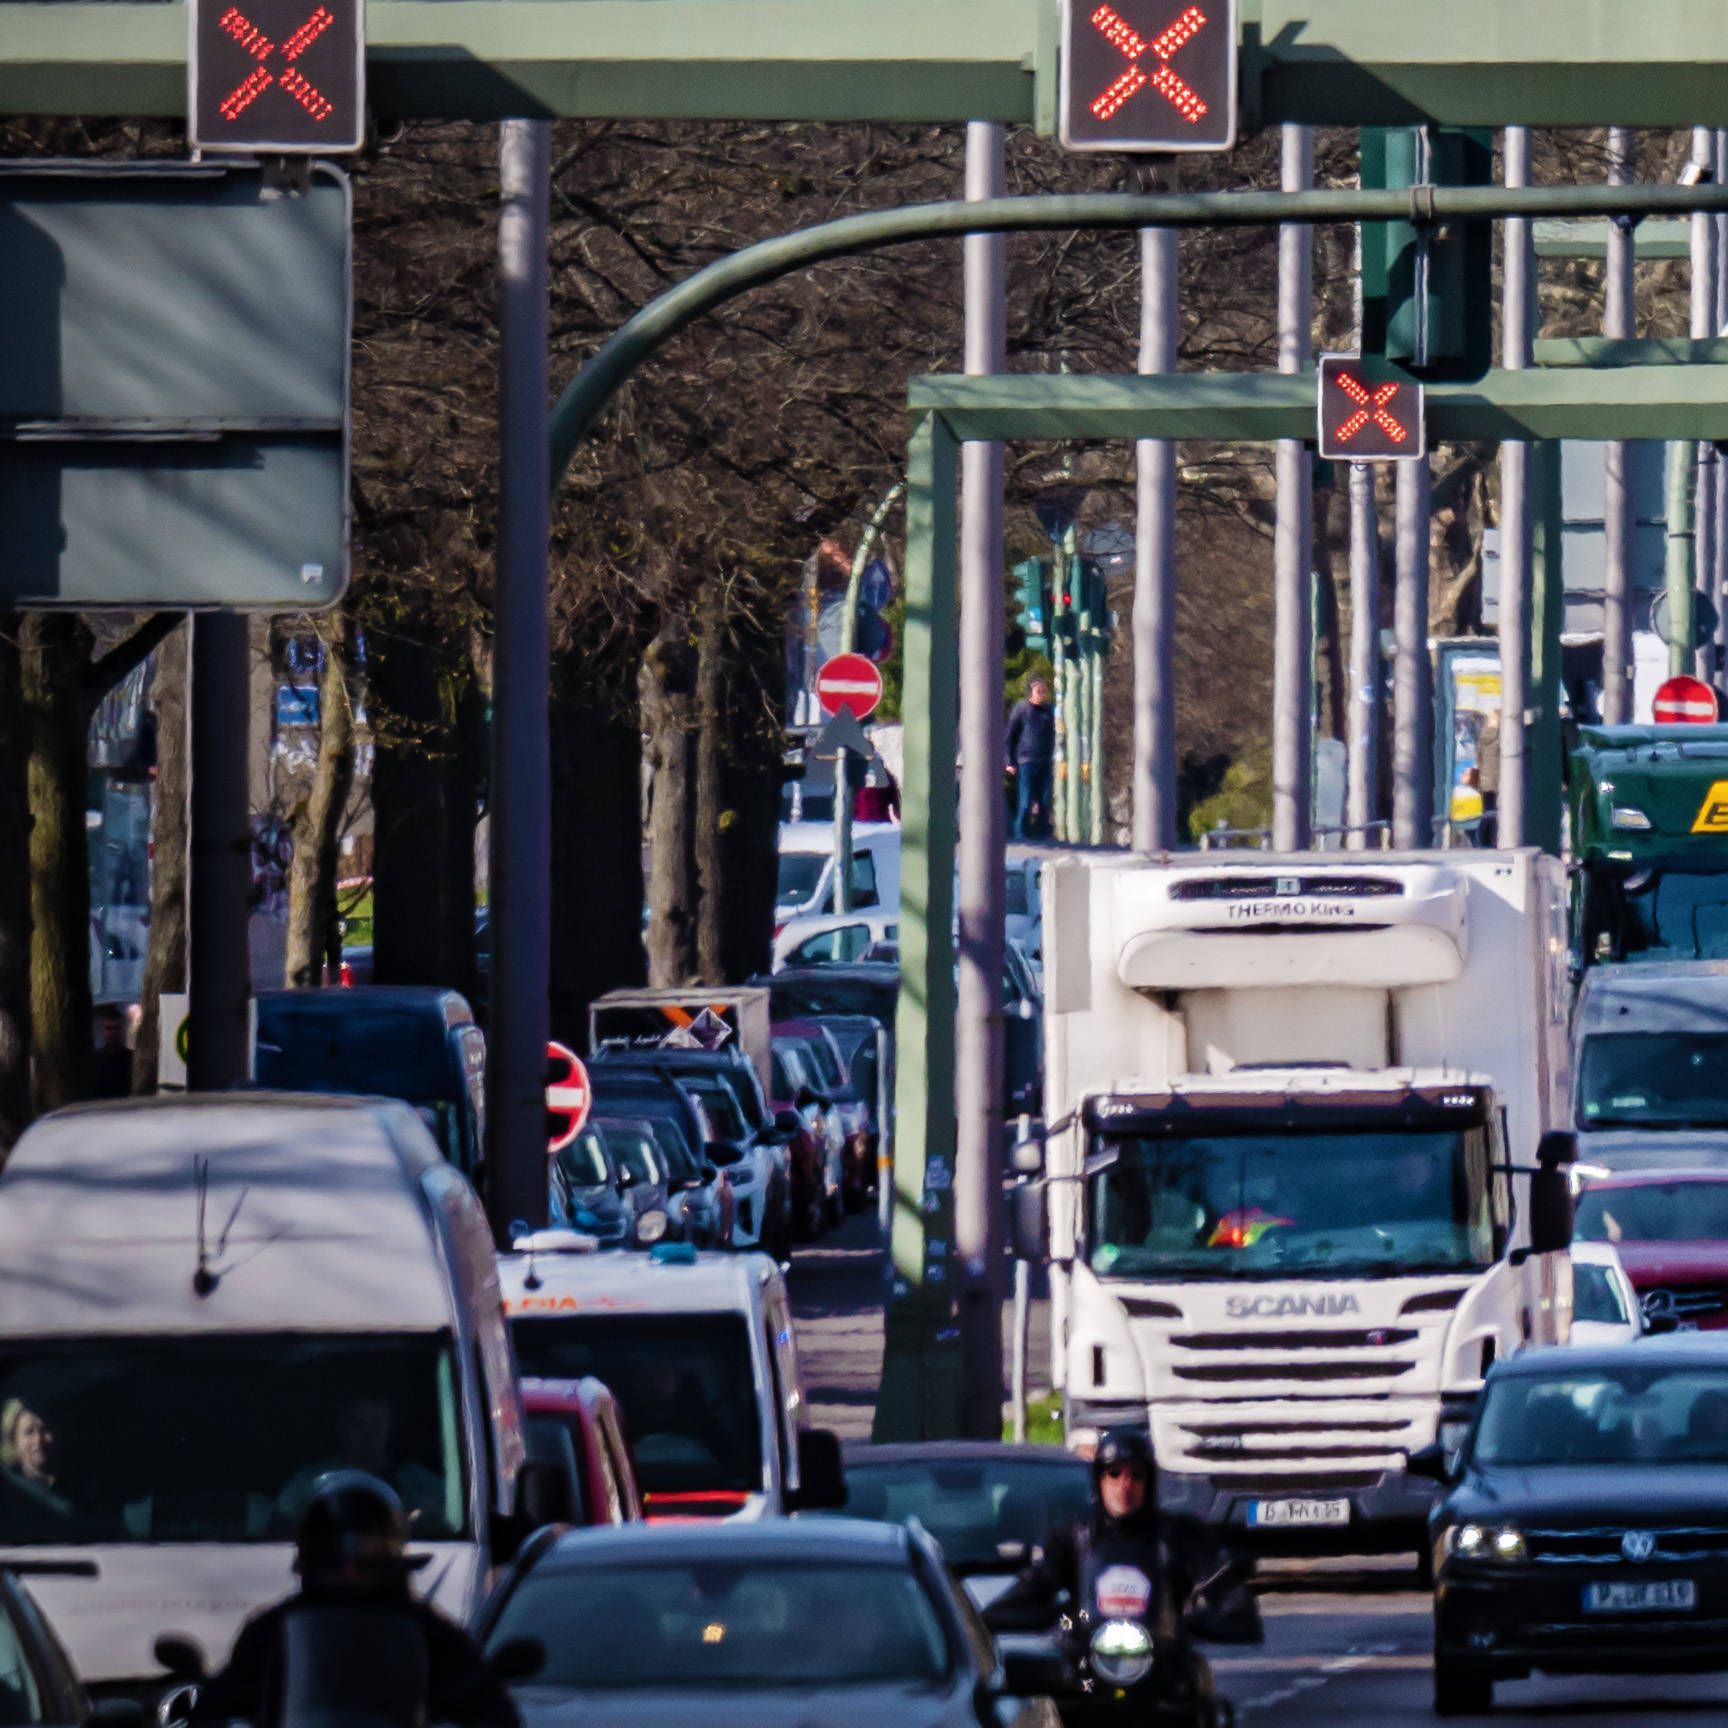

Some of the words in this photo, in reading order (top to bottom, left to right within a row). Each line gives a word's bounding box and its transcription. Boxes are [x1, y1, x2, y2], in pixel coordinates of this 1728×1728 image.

[1228, 903, 1305, 918] THERMO
[1311, 903, 1355, 917] KING
[1226, 1293, 1362, 1319] SCANIA
